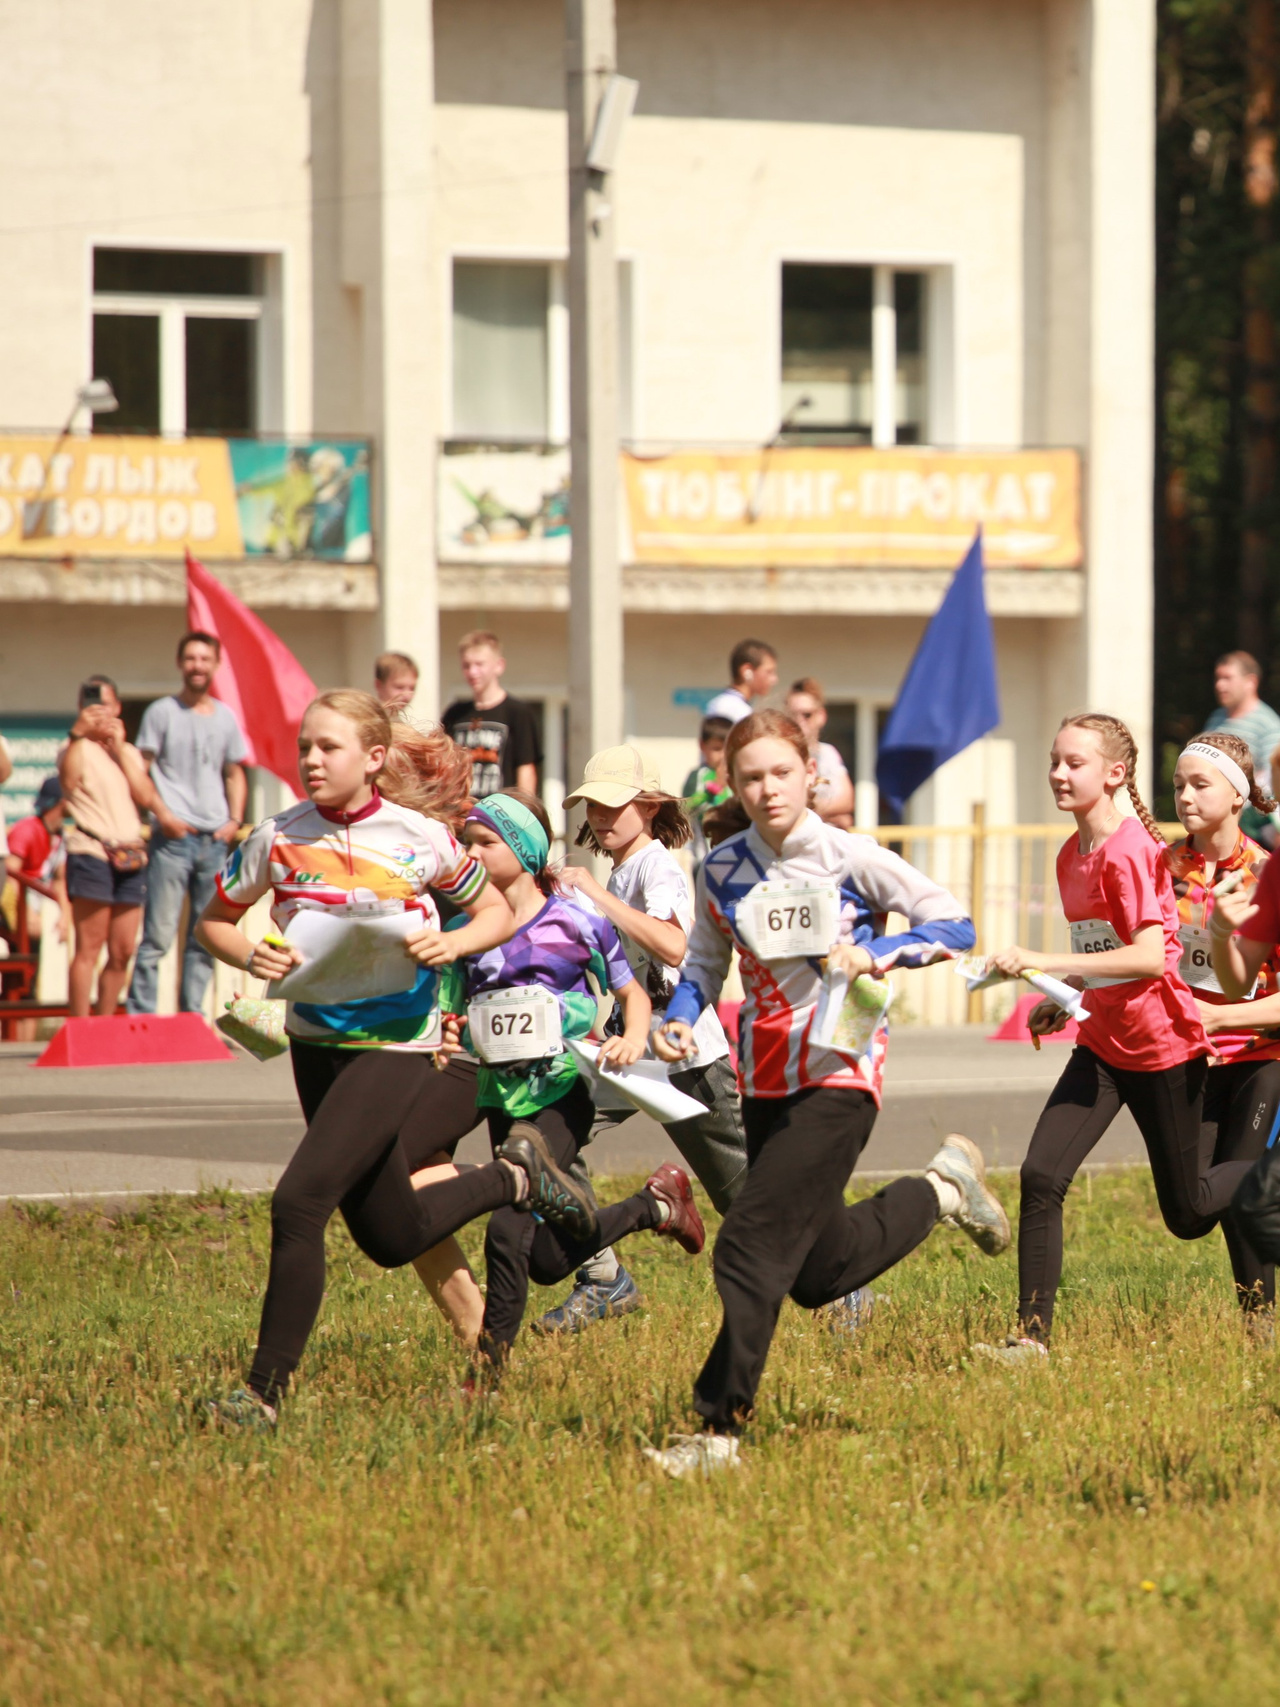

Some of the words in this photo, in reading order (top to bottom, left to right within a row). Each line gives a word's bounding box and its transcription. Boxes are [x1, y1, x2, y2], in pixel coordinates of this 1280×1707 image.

[83, 453, 201, 495] ЛЫЖ
[768, 905, 811, 932] 678
[491, 1012, 534, 1036] 672
